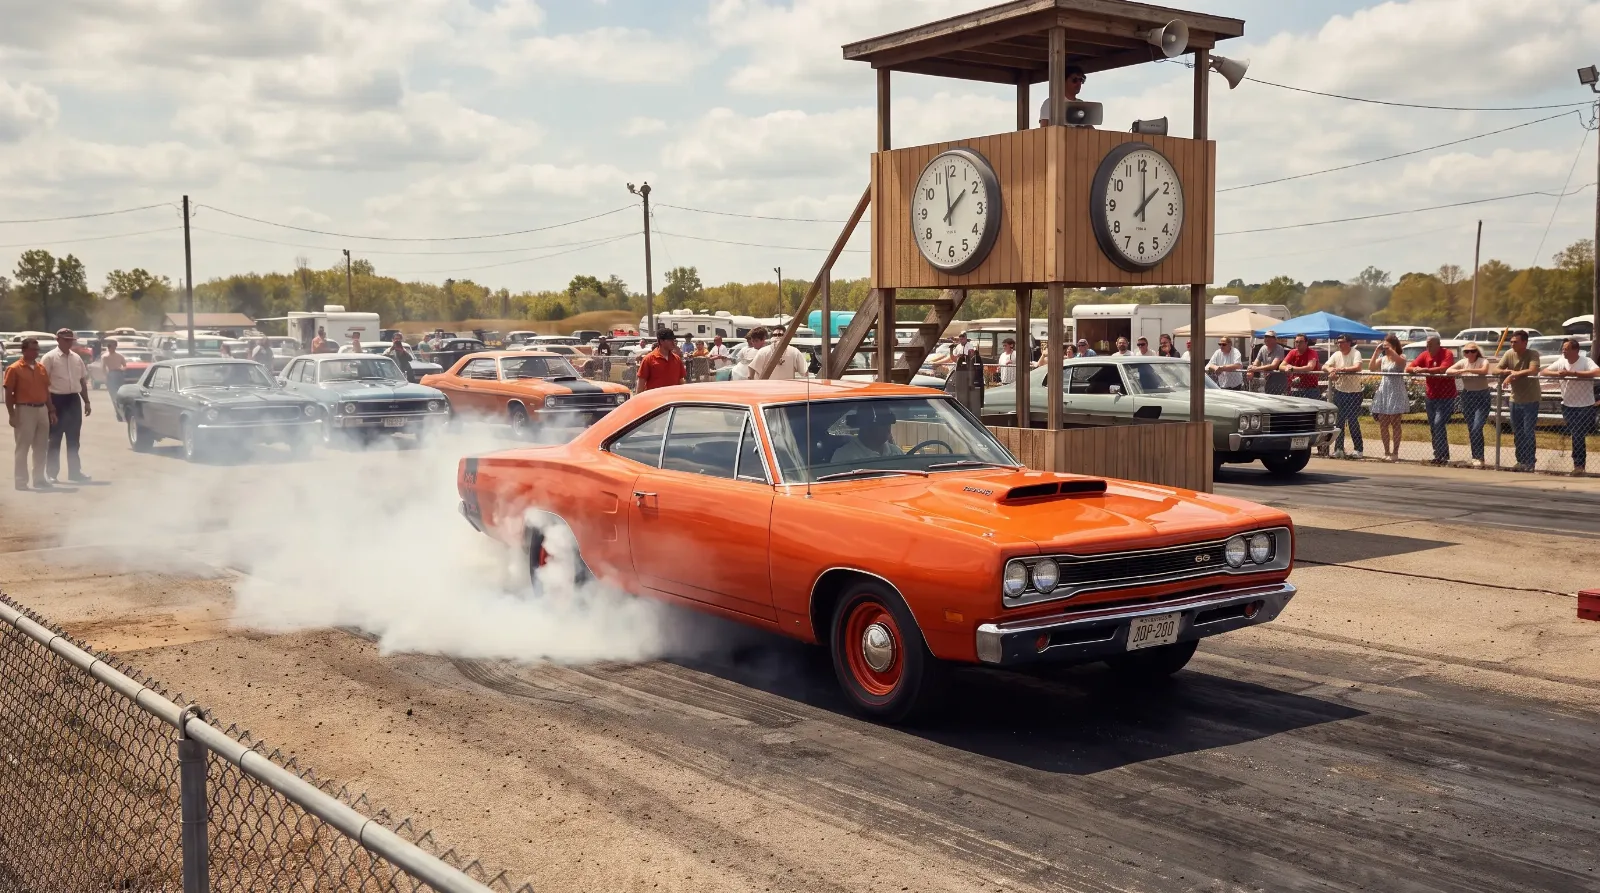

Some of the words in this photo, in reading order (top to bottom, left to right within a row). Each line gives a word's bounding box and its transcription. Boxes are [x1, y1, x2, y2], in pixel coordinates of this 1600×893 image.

[947, 165, 956, 178] 12
[1126, 165, 1132, 178] 11
[1138, 159, 1147, 173] 12
[936, 172, 942, 185] 11
[964, 168, 967, 181] 1
[1155, 167, 1158, 180] 1
[972, 181, 979, 194] 2
[1114, 179, 1124, 192] 10
[1163, 182, 1169, 195] 2
[925, 188, 935, 201] 10
[976, 202, 983, 215] 3
[1109, 199, 1116, 211] 9
[1167, 203, 1174, 216] 3
[921, 208, 928, 220] 9
[926, 228, 933, 240] 8
[972, 223, 979, 235] 4
[1113, 221, 1121, 234] 8
[1162, 223, 1169, 236] 4
[936, 241, 942, 254] 7
[962, 239, 969, 252] 5
[1124, 236, 1132, 249] 7
[1138, 242, 1145, 255] 6
[1152, 237, 1159, 250] 5
[948, 246, 955, 258] 6
